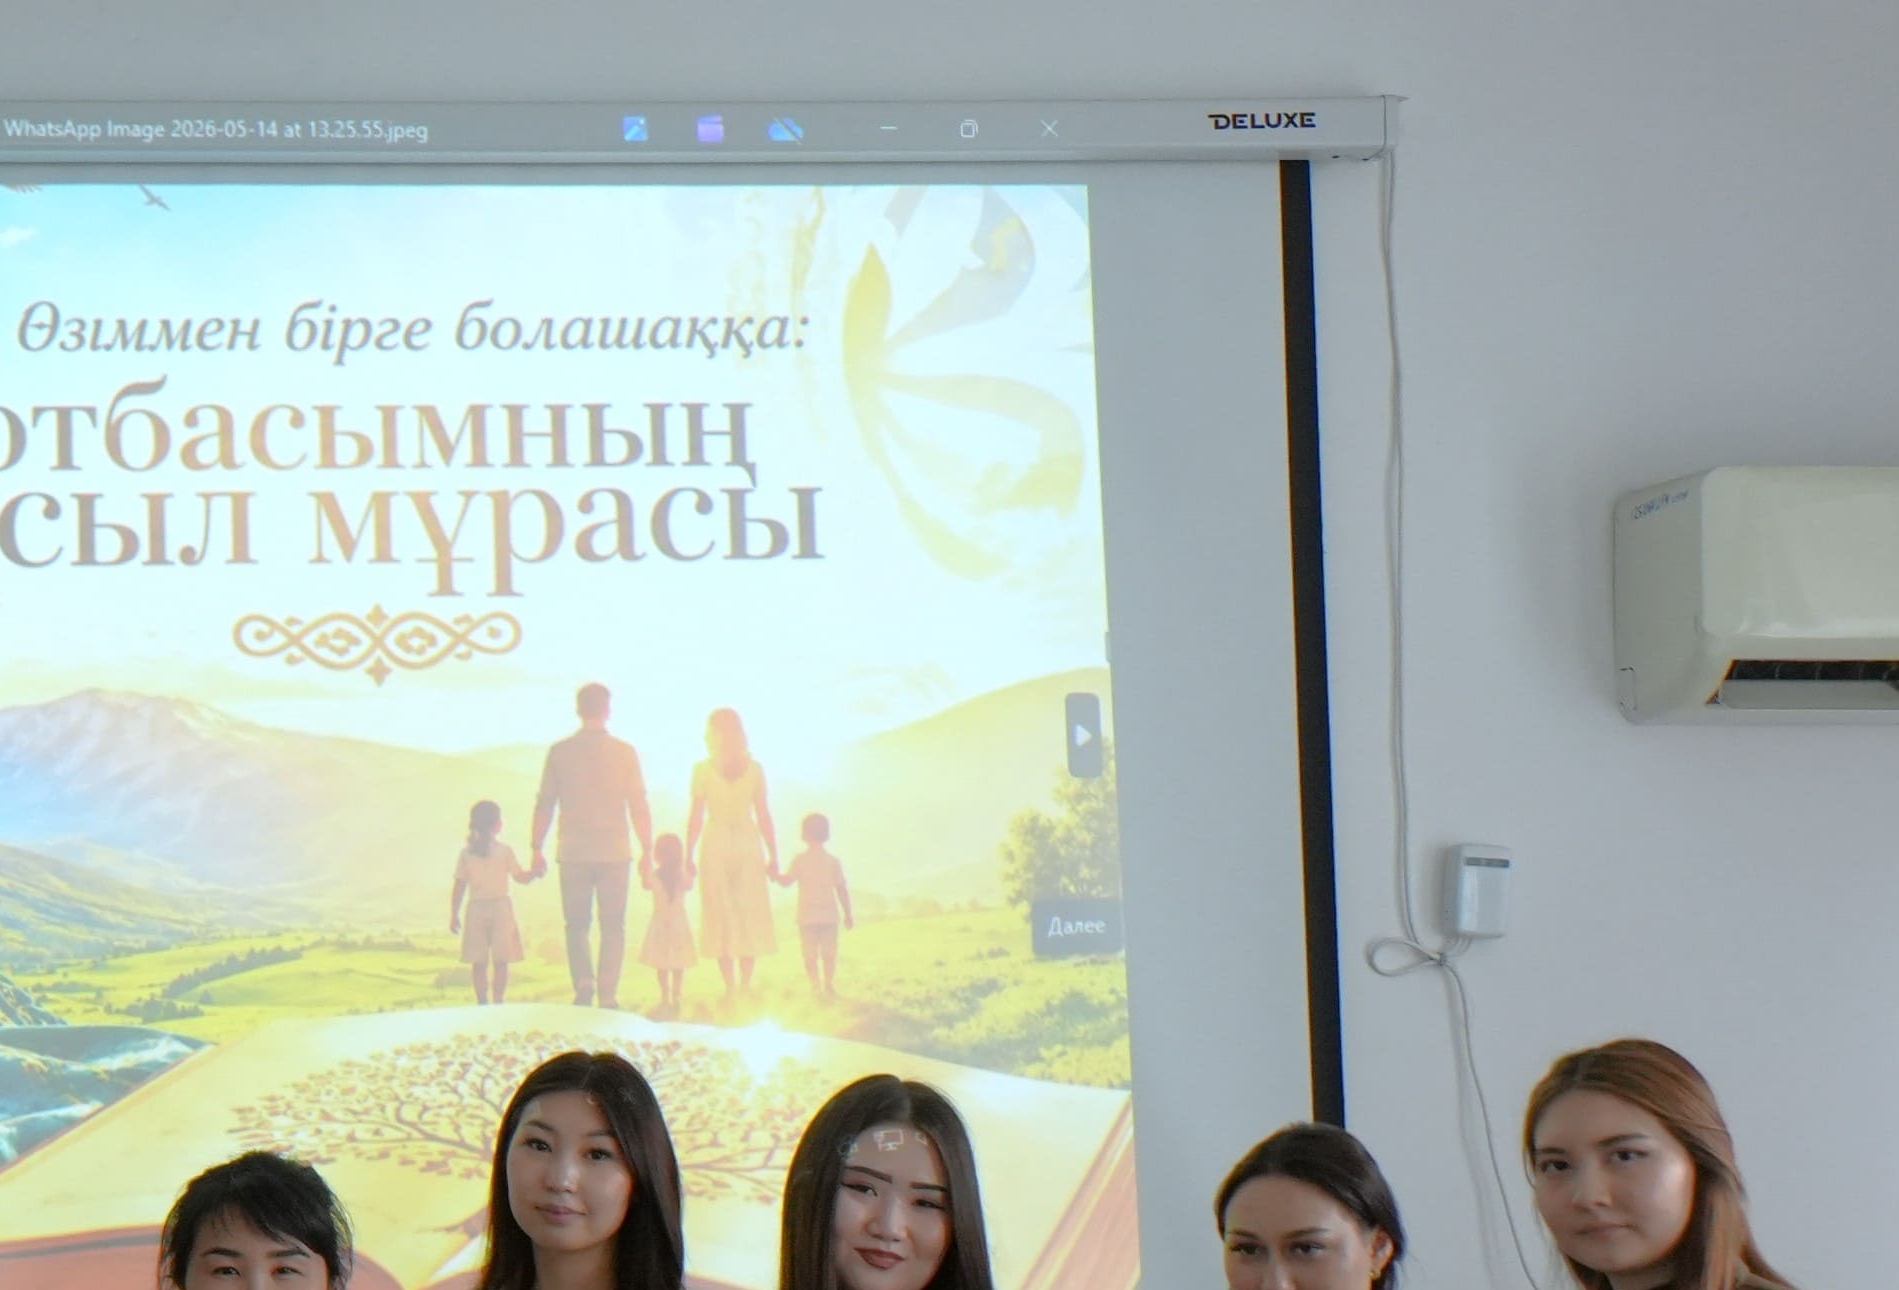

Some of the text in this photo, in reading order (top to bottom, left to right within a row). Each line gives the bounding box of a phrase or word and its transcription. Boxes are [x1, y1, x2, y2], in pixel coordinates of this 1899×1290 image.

[2, 118, 429, 144] WhatsApp Image 2026-05-14 at 13.25.55.jpeg
[1207, 111, 1317, 130] DELUXE
[284, 298, 434, 367] бірге
[454, 297, 810, 359] болашаққа:
[306, 486, 826, 598] мұрасы
[1047, 915, 1106, 938] Далее
